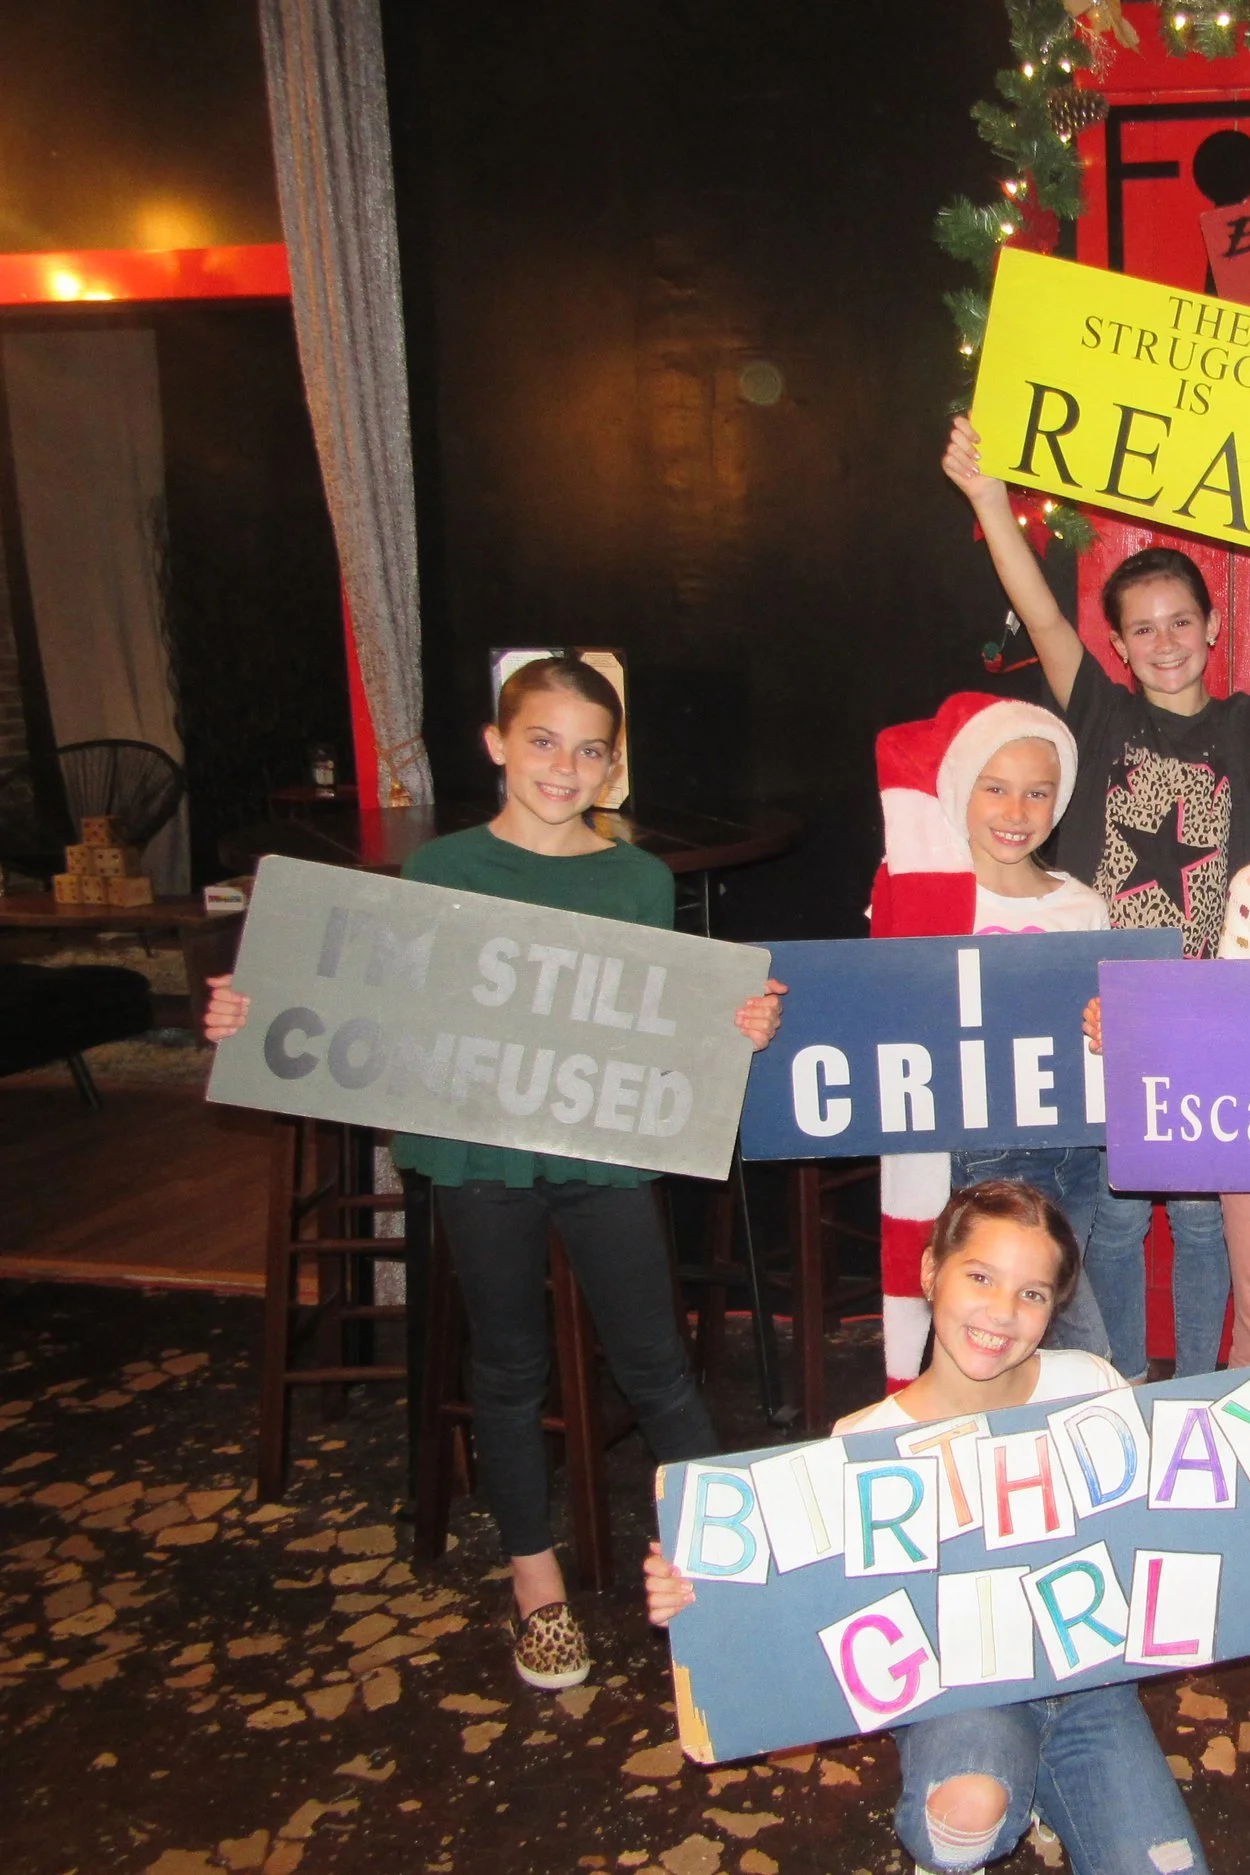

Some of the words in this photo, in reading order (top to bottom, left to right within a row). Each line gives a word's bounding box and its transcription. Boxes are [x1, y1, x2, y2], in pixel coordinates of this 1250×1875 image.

[1174, 378, 1212, 416] IS
[471, 937, 677, 1037] STILL
[957, 948, 983, 1028] I
[263, 1006, 694, 1138] CONFUSED
[839, 1556, 1200, 1715] GIRL
